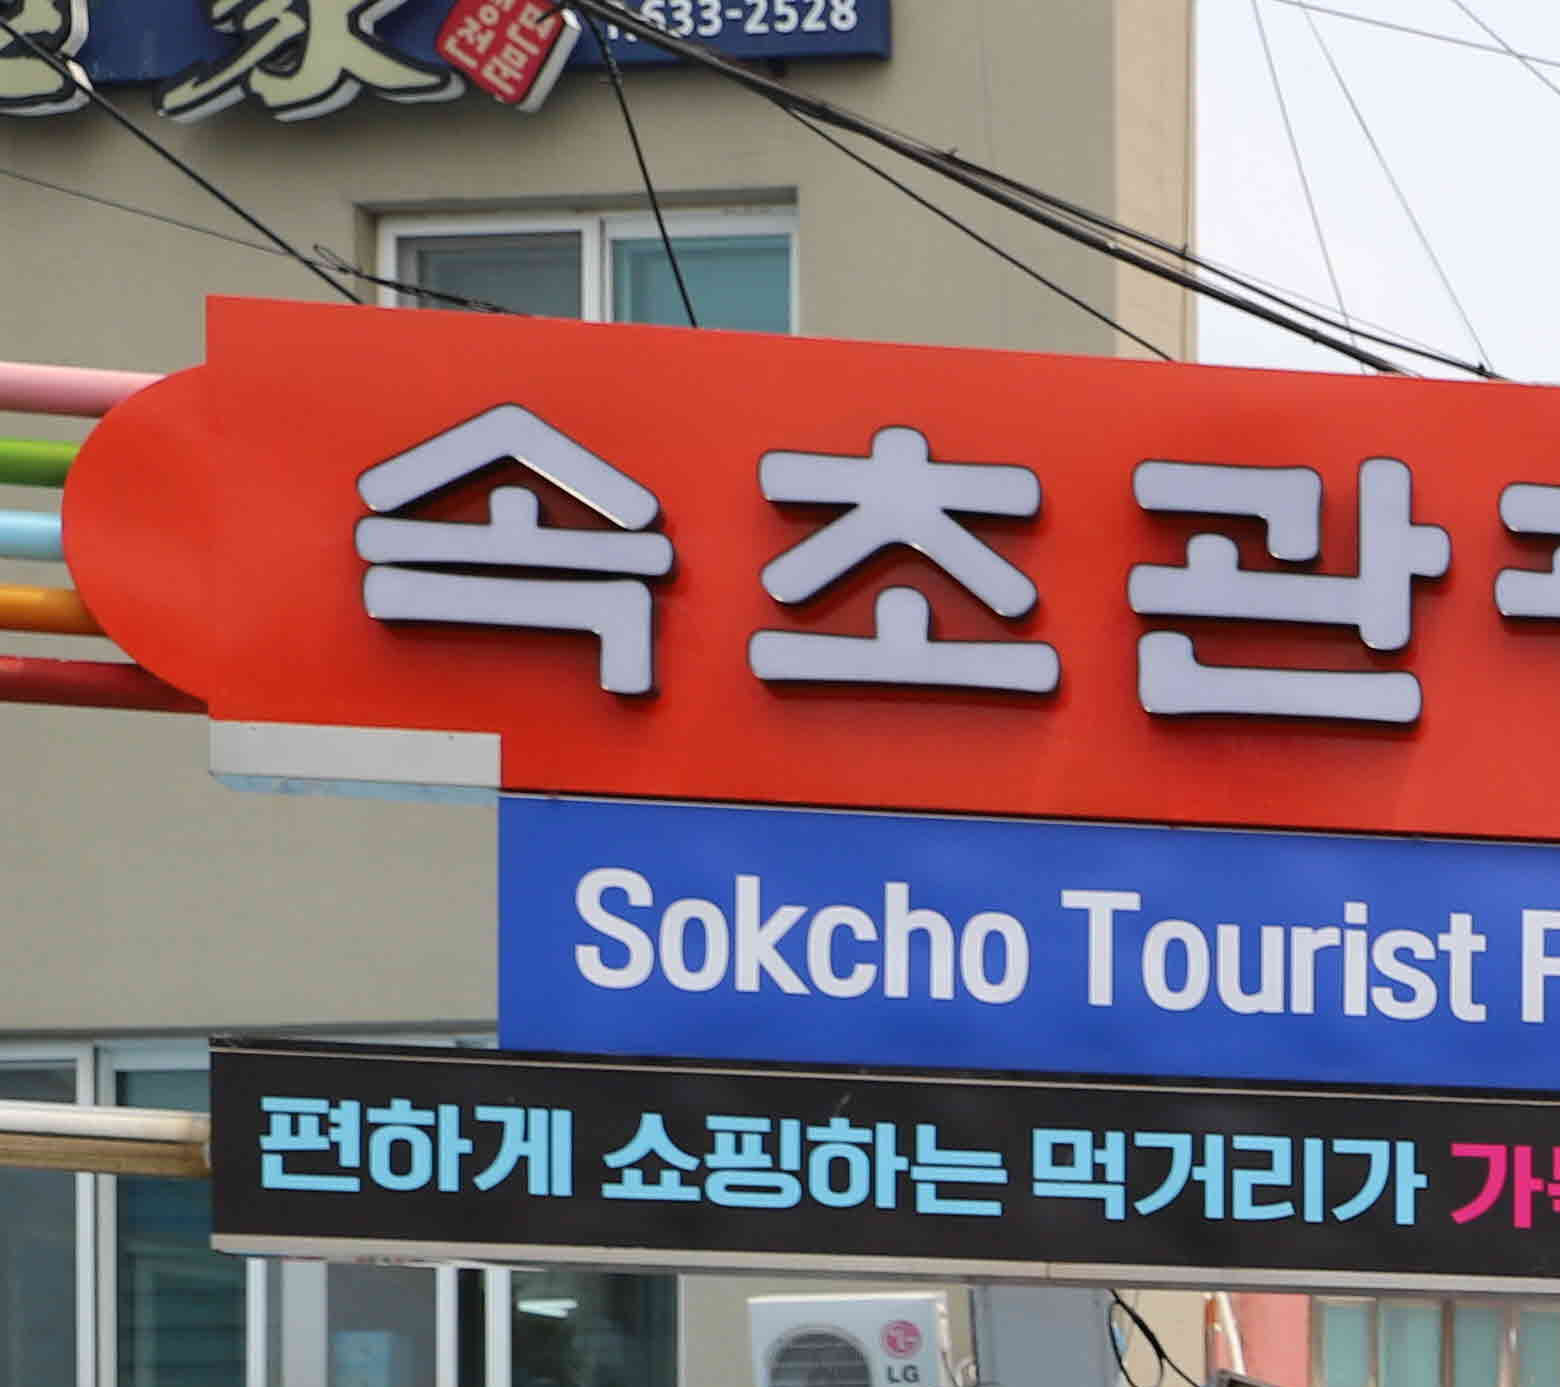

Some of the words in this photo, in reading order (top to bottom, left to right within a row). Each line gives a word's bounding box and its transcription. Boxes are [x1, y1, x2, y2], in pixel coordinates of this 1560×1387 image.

[572, 866, 1030, 1004] Sokcho
[1062, 890, 1486, 1024] Tourist
[259, 1095, 571, 1198] 편하게
[600, 1110, 1006, 1219] 쇼핑하는
[1031, 1125, 1425, 1226] 먹거리가
[887, 1365, 919, 1383] LG
